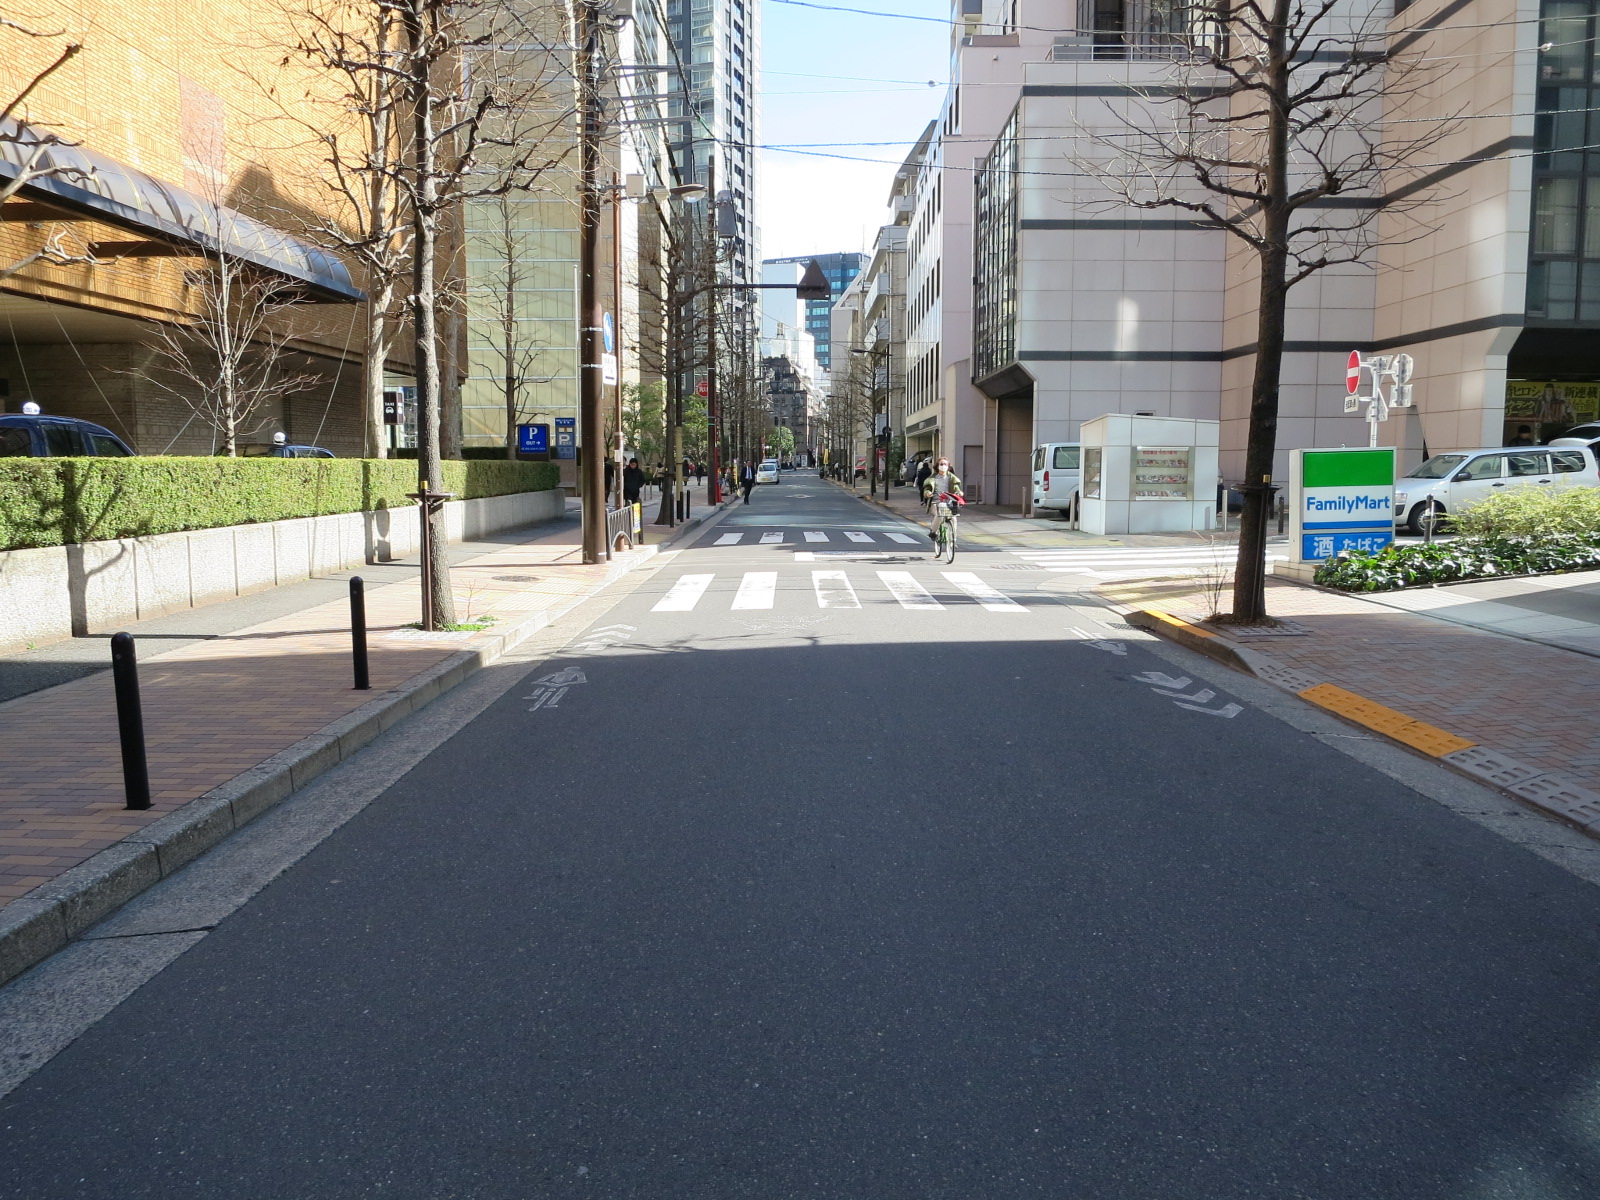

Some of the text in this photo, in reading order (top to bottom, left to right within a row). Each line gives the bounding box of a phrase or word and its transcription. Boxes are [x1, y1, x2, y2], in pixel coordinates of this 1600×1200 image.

[1564, 386, 1598, 399] 新連載
[529, 427, 538, 440] P
[559, 434, 570, 445] P
[1306, 495, 1390, 514] FamilyMart
[1313, 536, 1386, 558] 酒 たばこ
